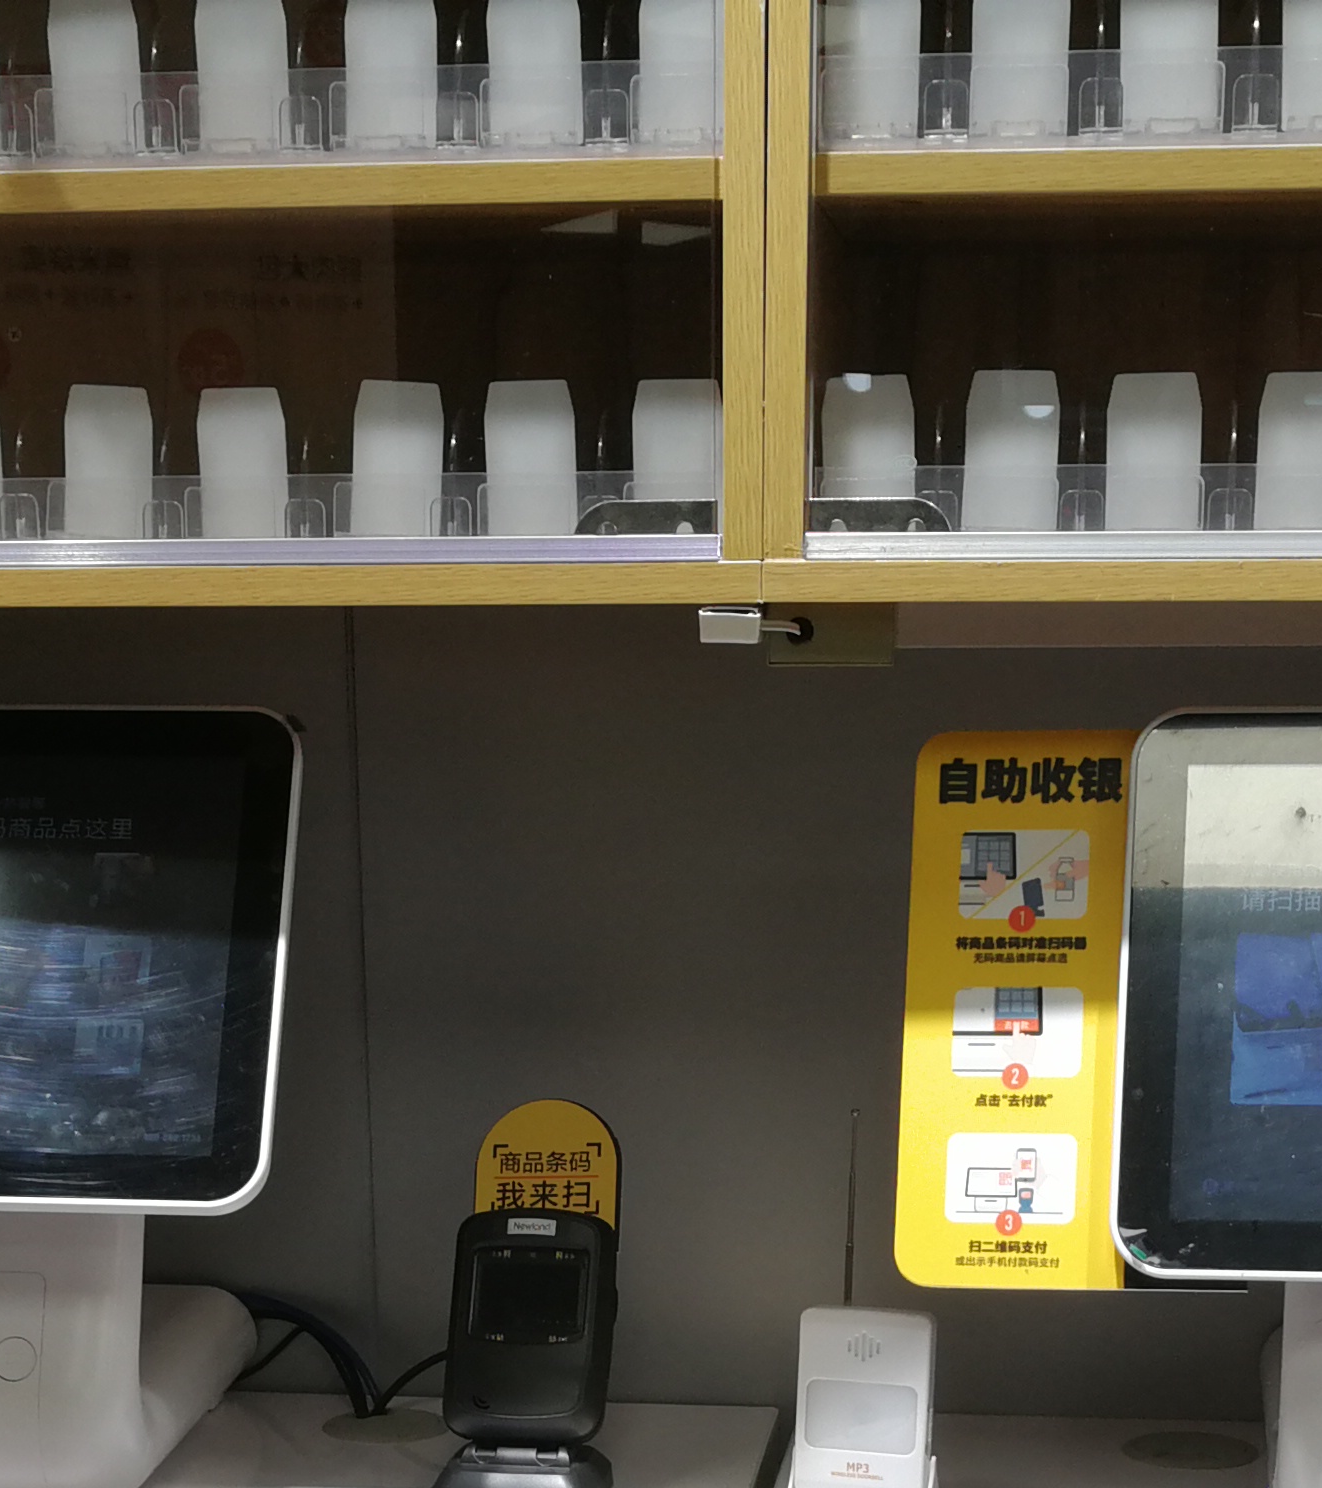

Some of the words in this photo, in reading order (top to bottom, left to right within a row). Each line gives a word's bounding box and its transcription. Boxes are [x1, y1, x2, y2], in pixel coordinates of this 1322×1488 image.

[938, 757, 1124, 805] 自助收银
[955, 935, 1088, 951] 将商品条码对准扫码器
[1010, 1068, 1020, 1085] 2
[974, 1093, 1054, 1108] 点击“去付款”
[499, 1150, 592, 1175] 商品条码
[495, 1180, 591, 1209] 我来扫
[1004, 1214, 1014, 1232] 3
[968, 1239, 1048, 1255] 扫二维码支付
[955, 1255, 1060, 1269] 或出示手机付款码支付
[846, 1462, 870, 1474] MP3
